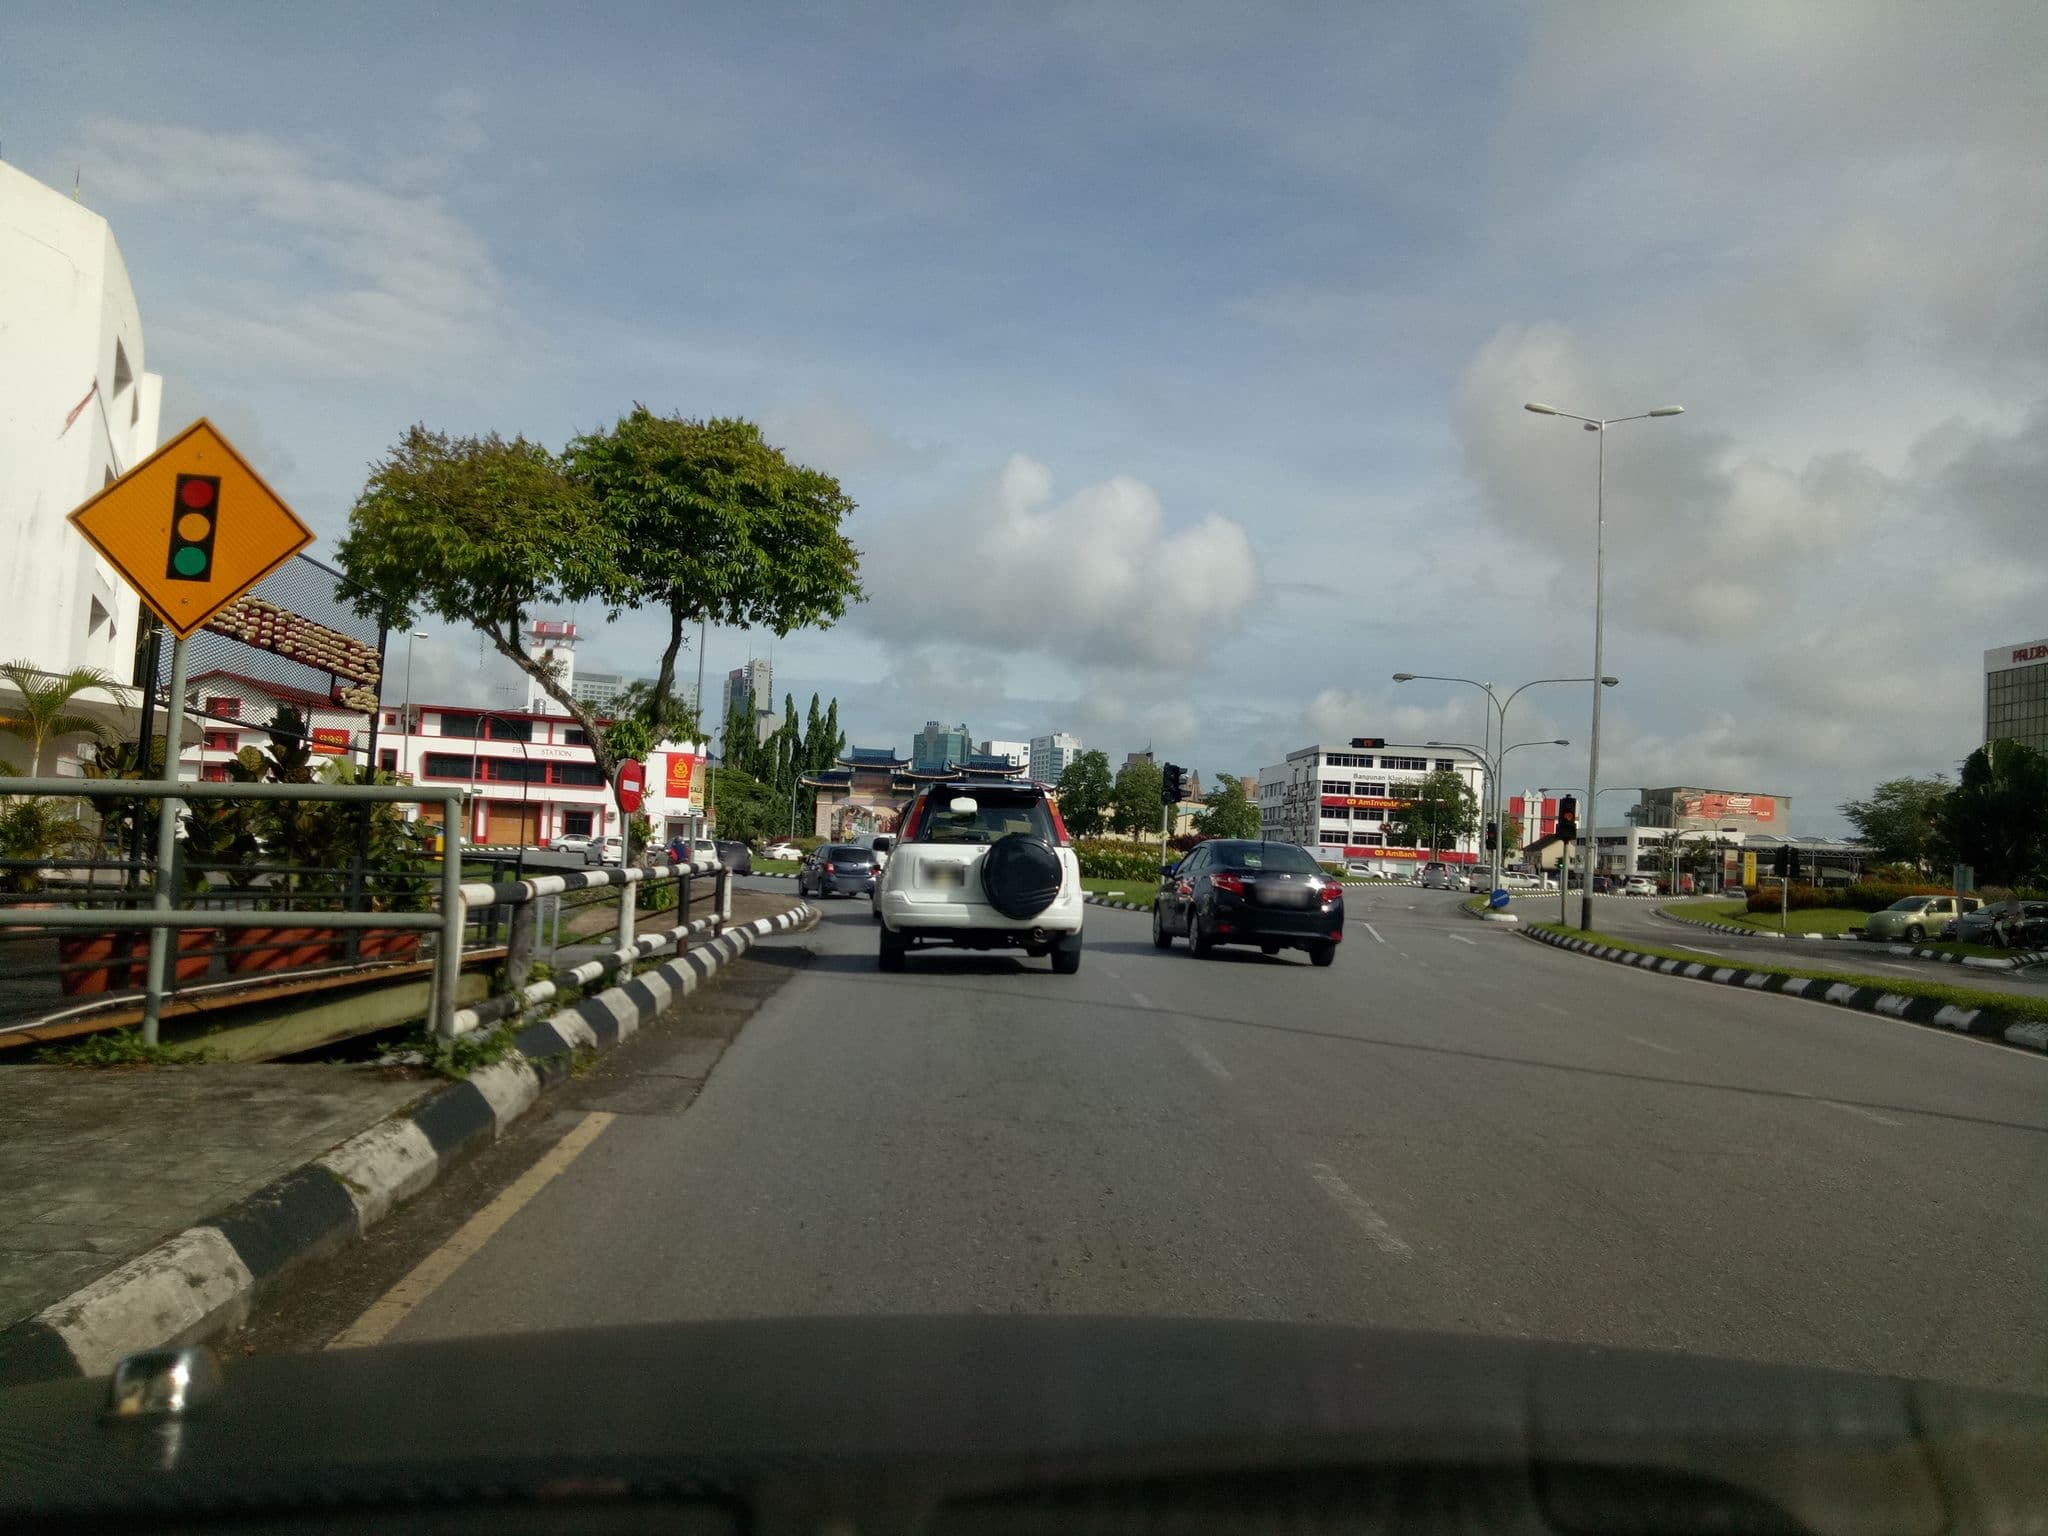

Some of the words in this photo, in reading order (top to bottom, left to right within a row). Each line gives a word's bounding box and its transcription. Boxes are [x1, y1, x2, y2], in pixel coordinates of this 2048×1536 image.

[542, 748, 572, 757] STATION
[1353, 773, 1386, 781] Bangunan
[1386, 850, 1418, 858] AmBank
